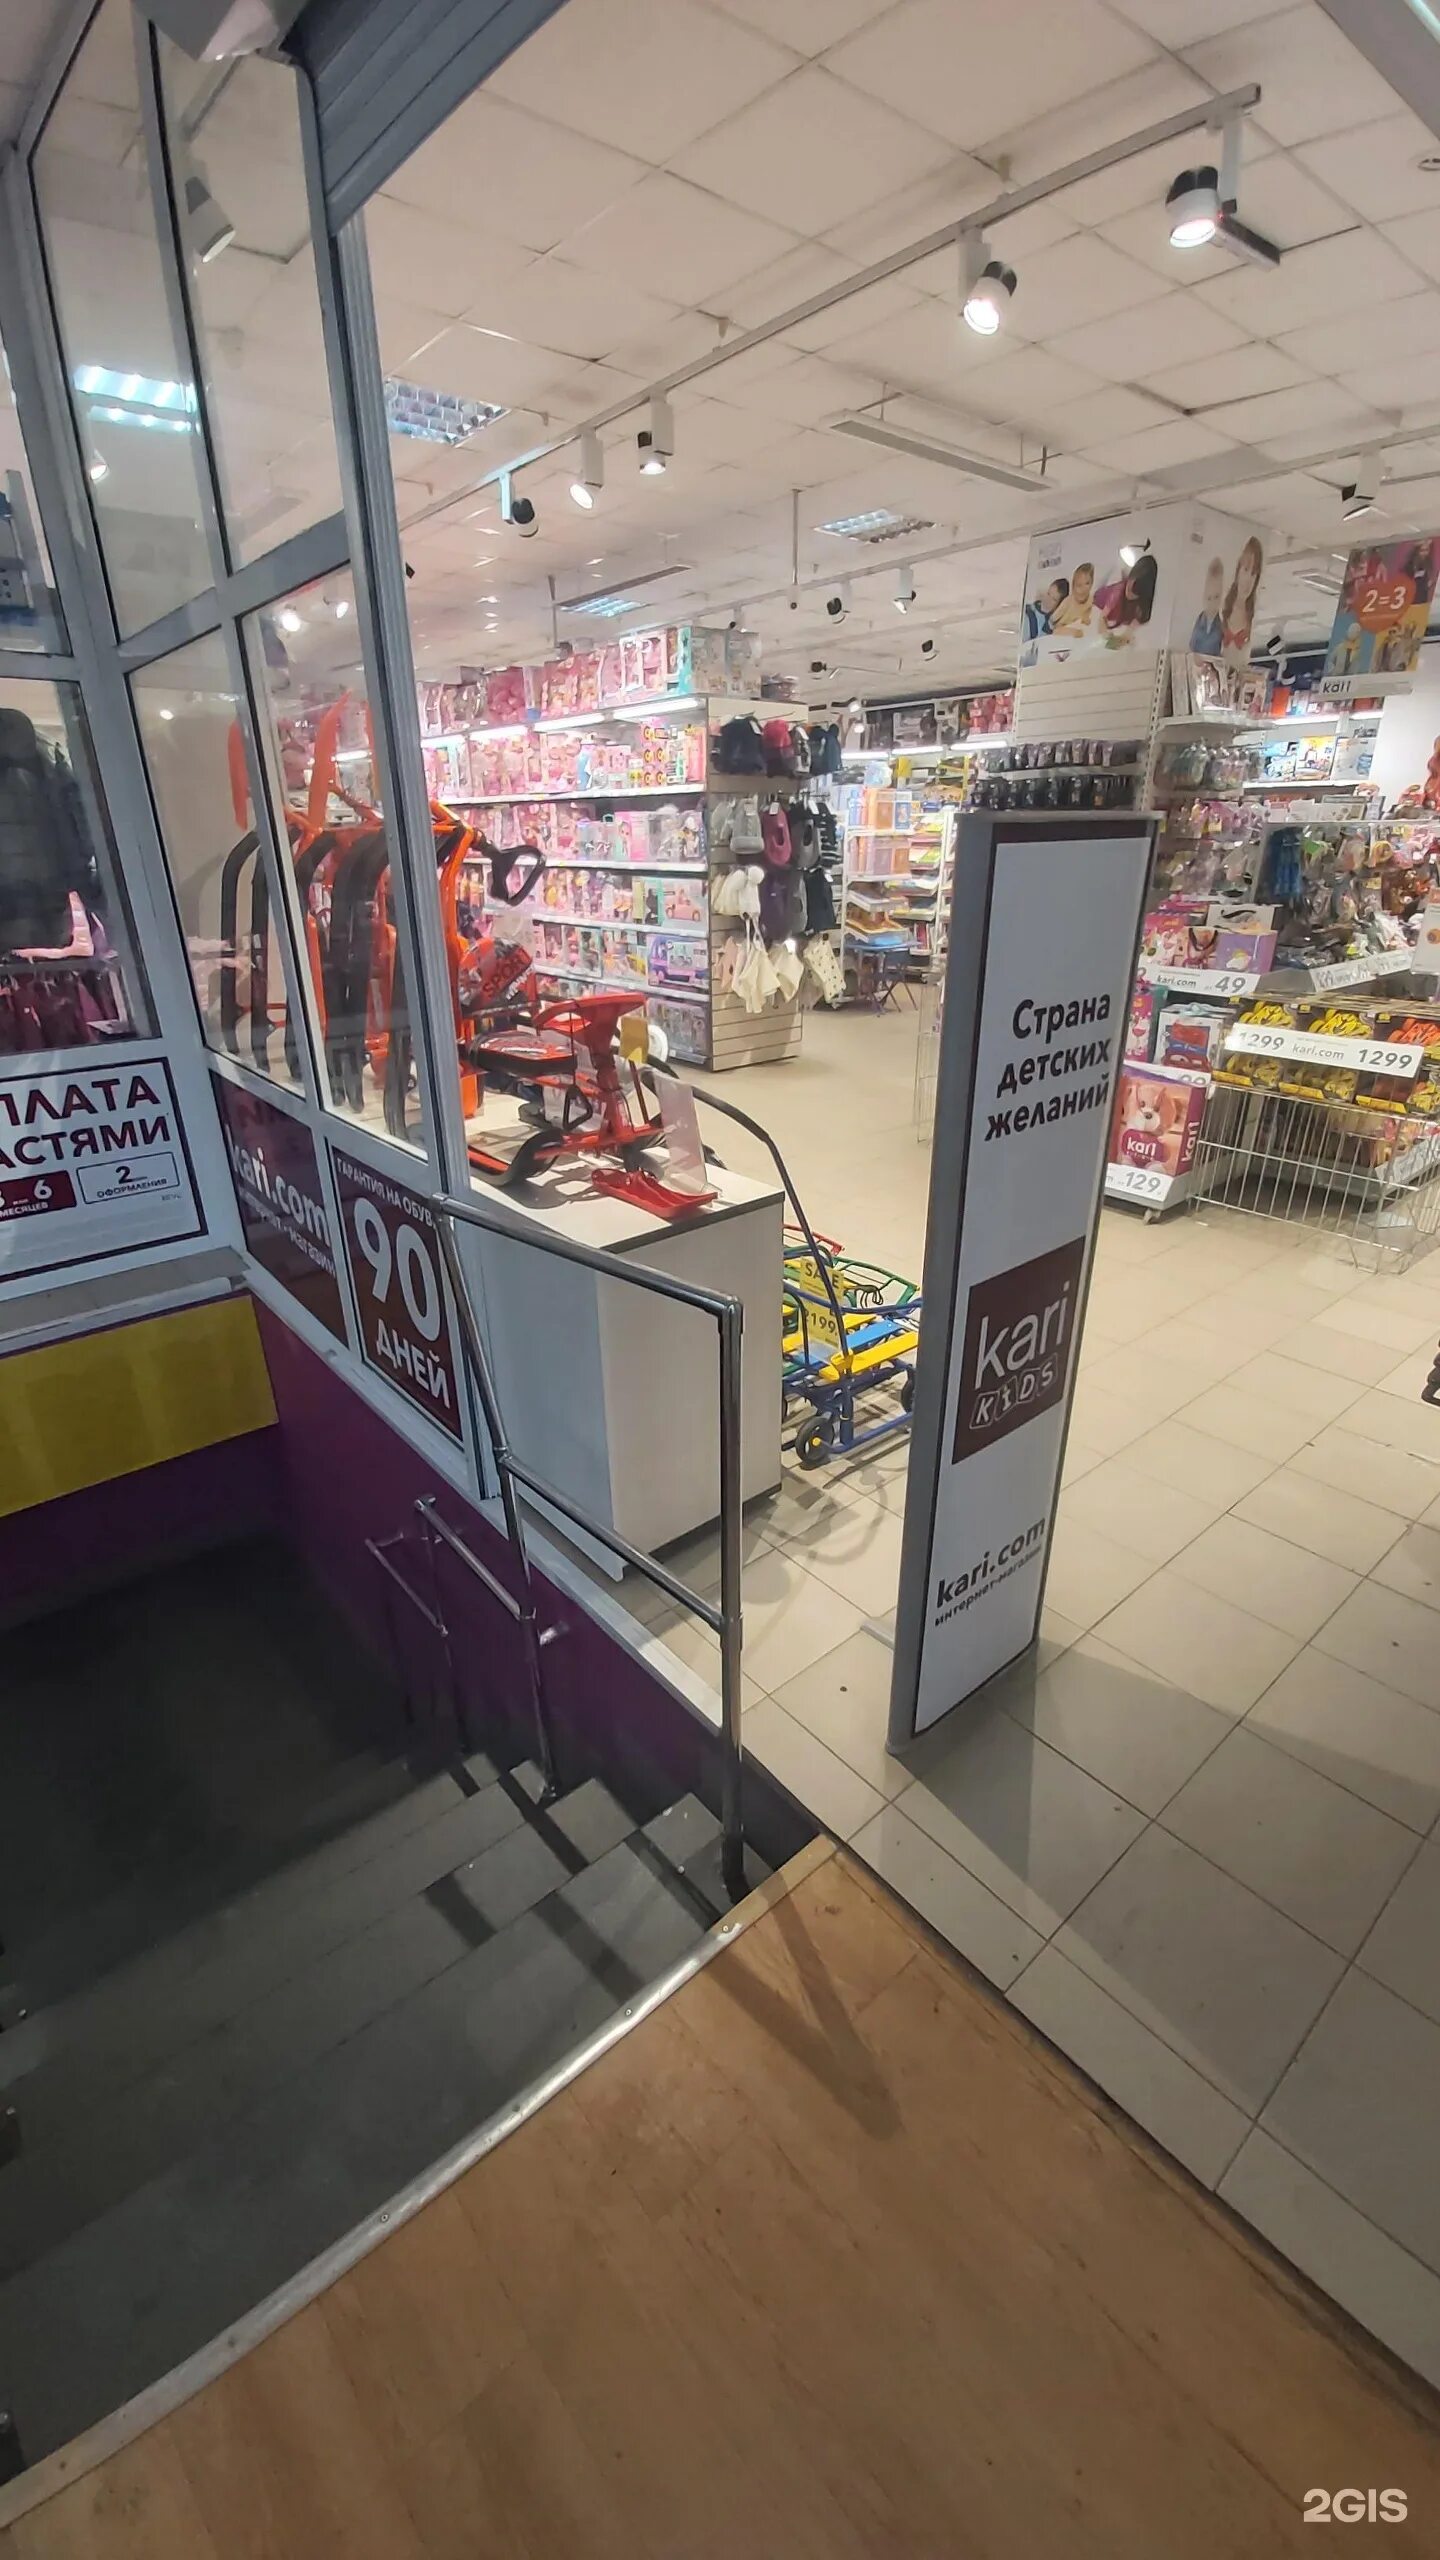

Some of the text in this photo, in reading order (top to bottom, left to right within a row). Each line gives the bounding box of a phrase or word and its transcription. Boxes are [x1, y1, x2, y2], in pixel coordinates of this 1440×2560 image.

[1362, 586, 1406, 613] 2=3
[1157, 975, 1246, 993] kari.com 49
[1012, 994, 1111, 1044] Страна
[996, 1038, 1111, 1099] детских
[1292, 1044, 1345, 1061] kari.com
[1358, 1049, 1413, 1070] 1299
[984, 1072, 1110, 1142] желаний
[1127, 1136, 1157, 1156] kari
[33, 1179, 53, 1200] 6
[97, 1179, 167, 1198] ОФОРМЛЕНИЯ
[115, 1166, 133, 1184] 2
[225, 1123, 331, 1248] kari.com
[337, 1157, 437, 1228] ГАРАНТИЯ НА ОБУВ
[1126, 1171, 1161, 1193] 129
[354, 1197, 440, 1342] 90
[974, 1280, 1070, 1390] kari
[376, 1318, 451, 1409] ДНЕЙ
[975, 1360, 1055, 1425] KIDS
[936, 1518, 1046, 1609] kari.com
